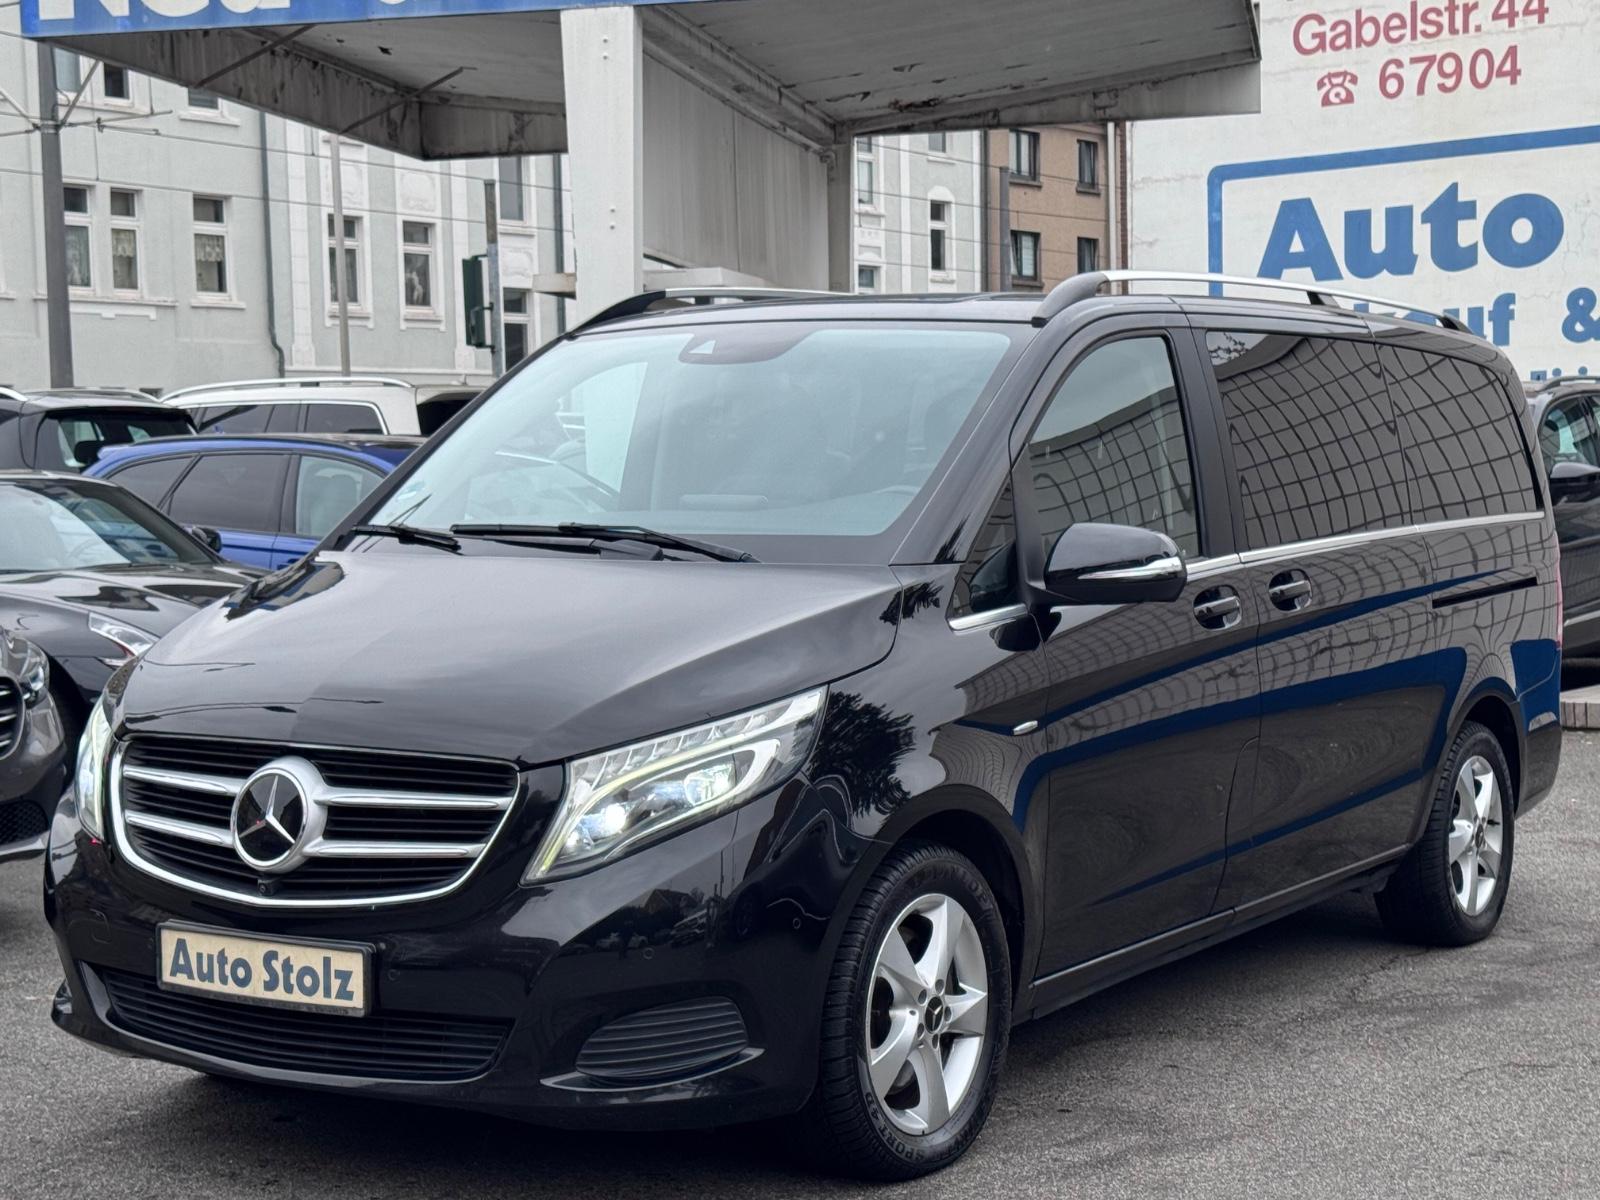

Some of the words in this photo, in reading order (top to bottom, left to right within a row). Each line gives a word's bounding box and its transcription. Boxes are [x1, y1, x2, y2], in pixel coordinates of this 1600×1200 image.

[1293, 0, 1482, 56] Gabelstr.
[1492, 0, 1549, 28] 44
[1379, 45, 1522, 100] 67904
[1257, 182, 1564, 282] Auto
[1561, 287, 1600, 343] &
[169, 938, 253, 988] Auto
[262, 950, 355, 1001] Stolz
